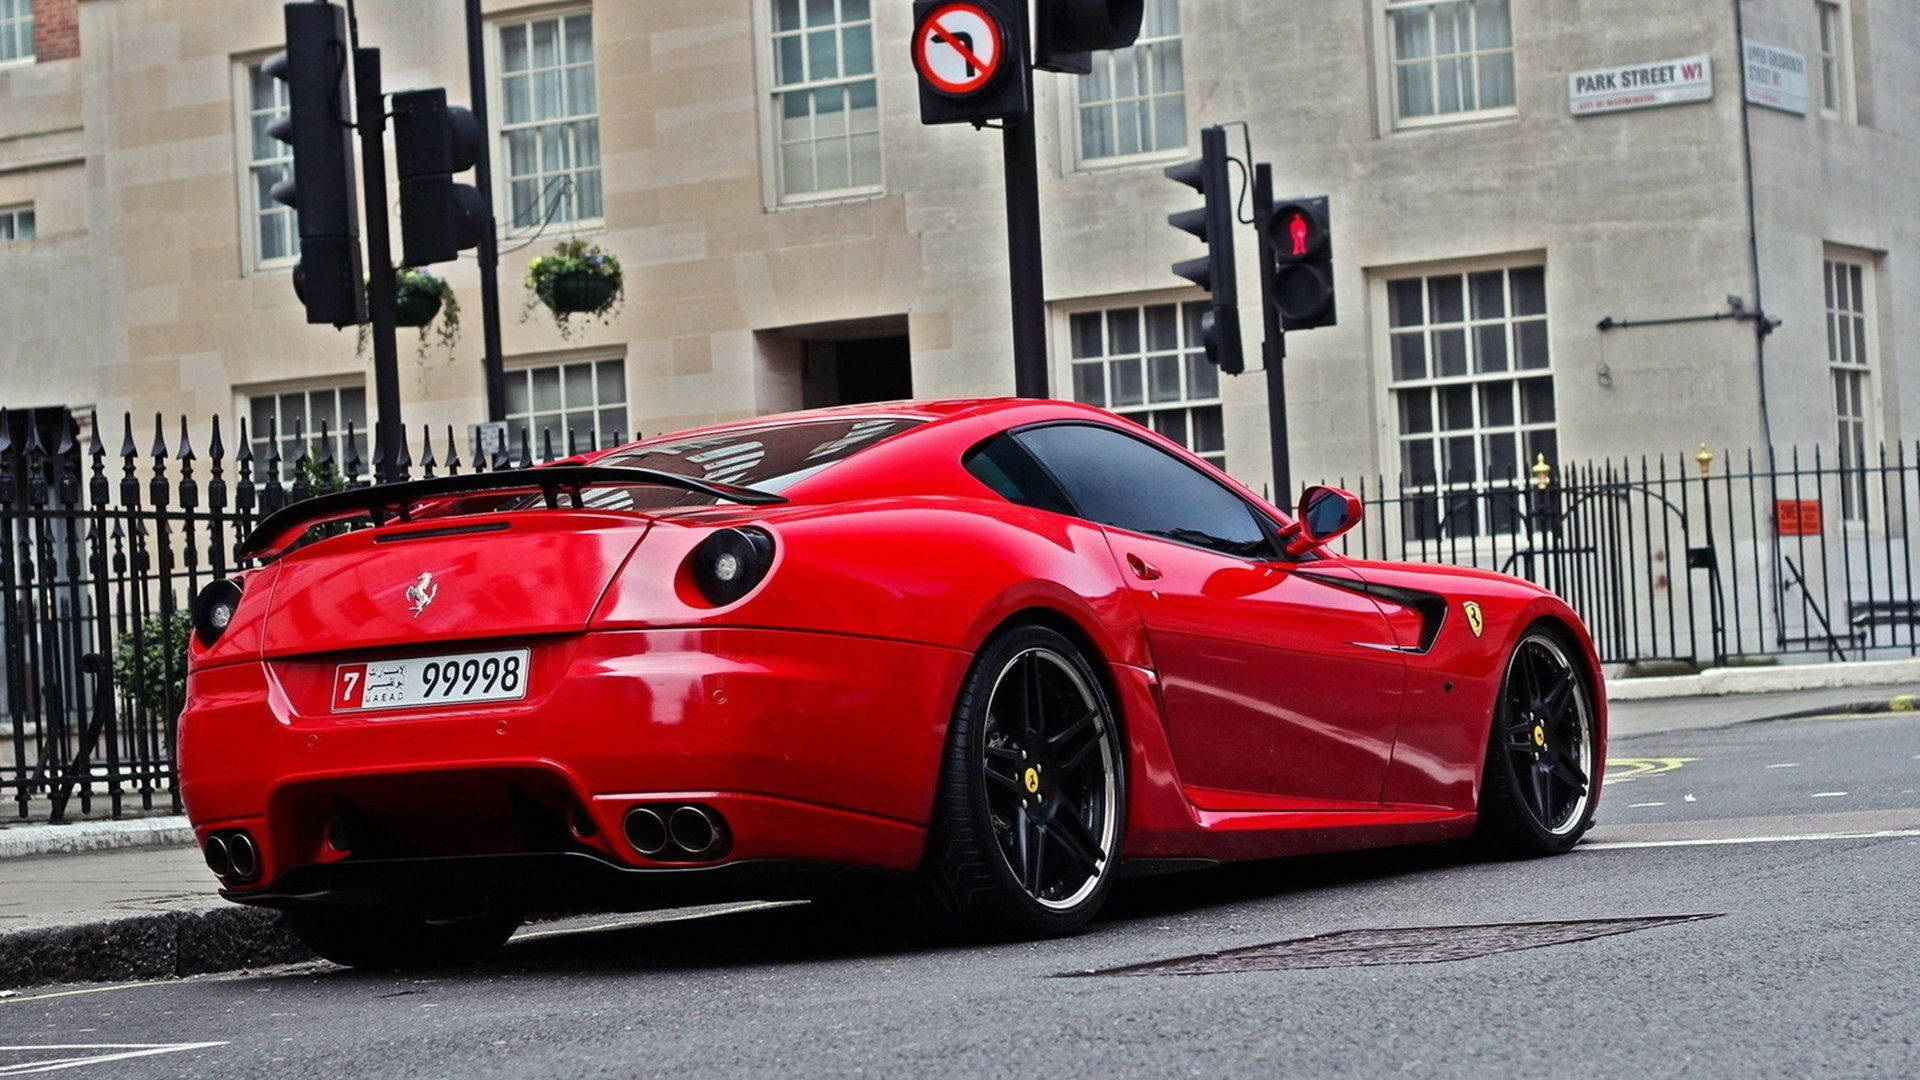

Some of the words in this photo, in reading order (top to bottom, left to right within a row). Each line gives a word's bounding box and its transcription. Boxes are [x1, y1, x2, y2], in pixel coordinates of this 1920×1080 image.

[1576, 72, 1616, 93] PARK
[1620, 64, 1676, 88] STREET
[1681, 60, 1703, 80] W1
[343, 672, 360, 702] 7
[422, 656, 521, 698] 99998
